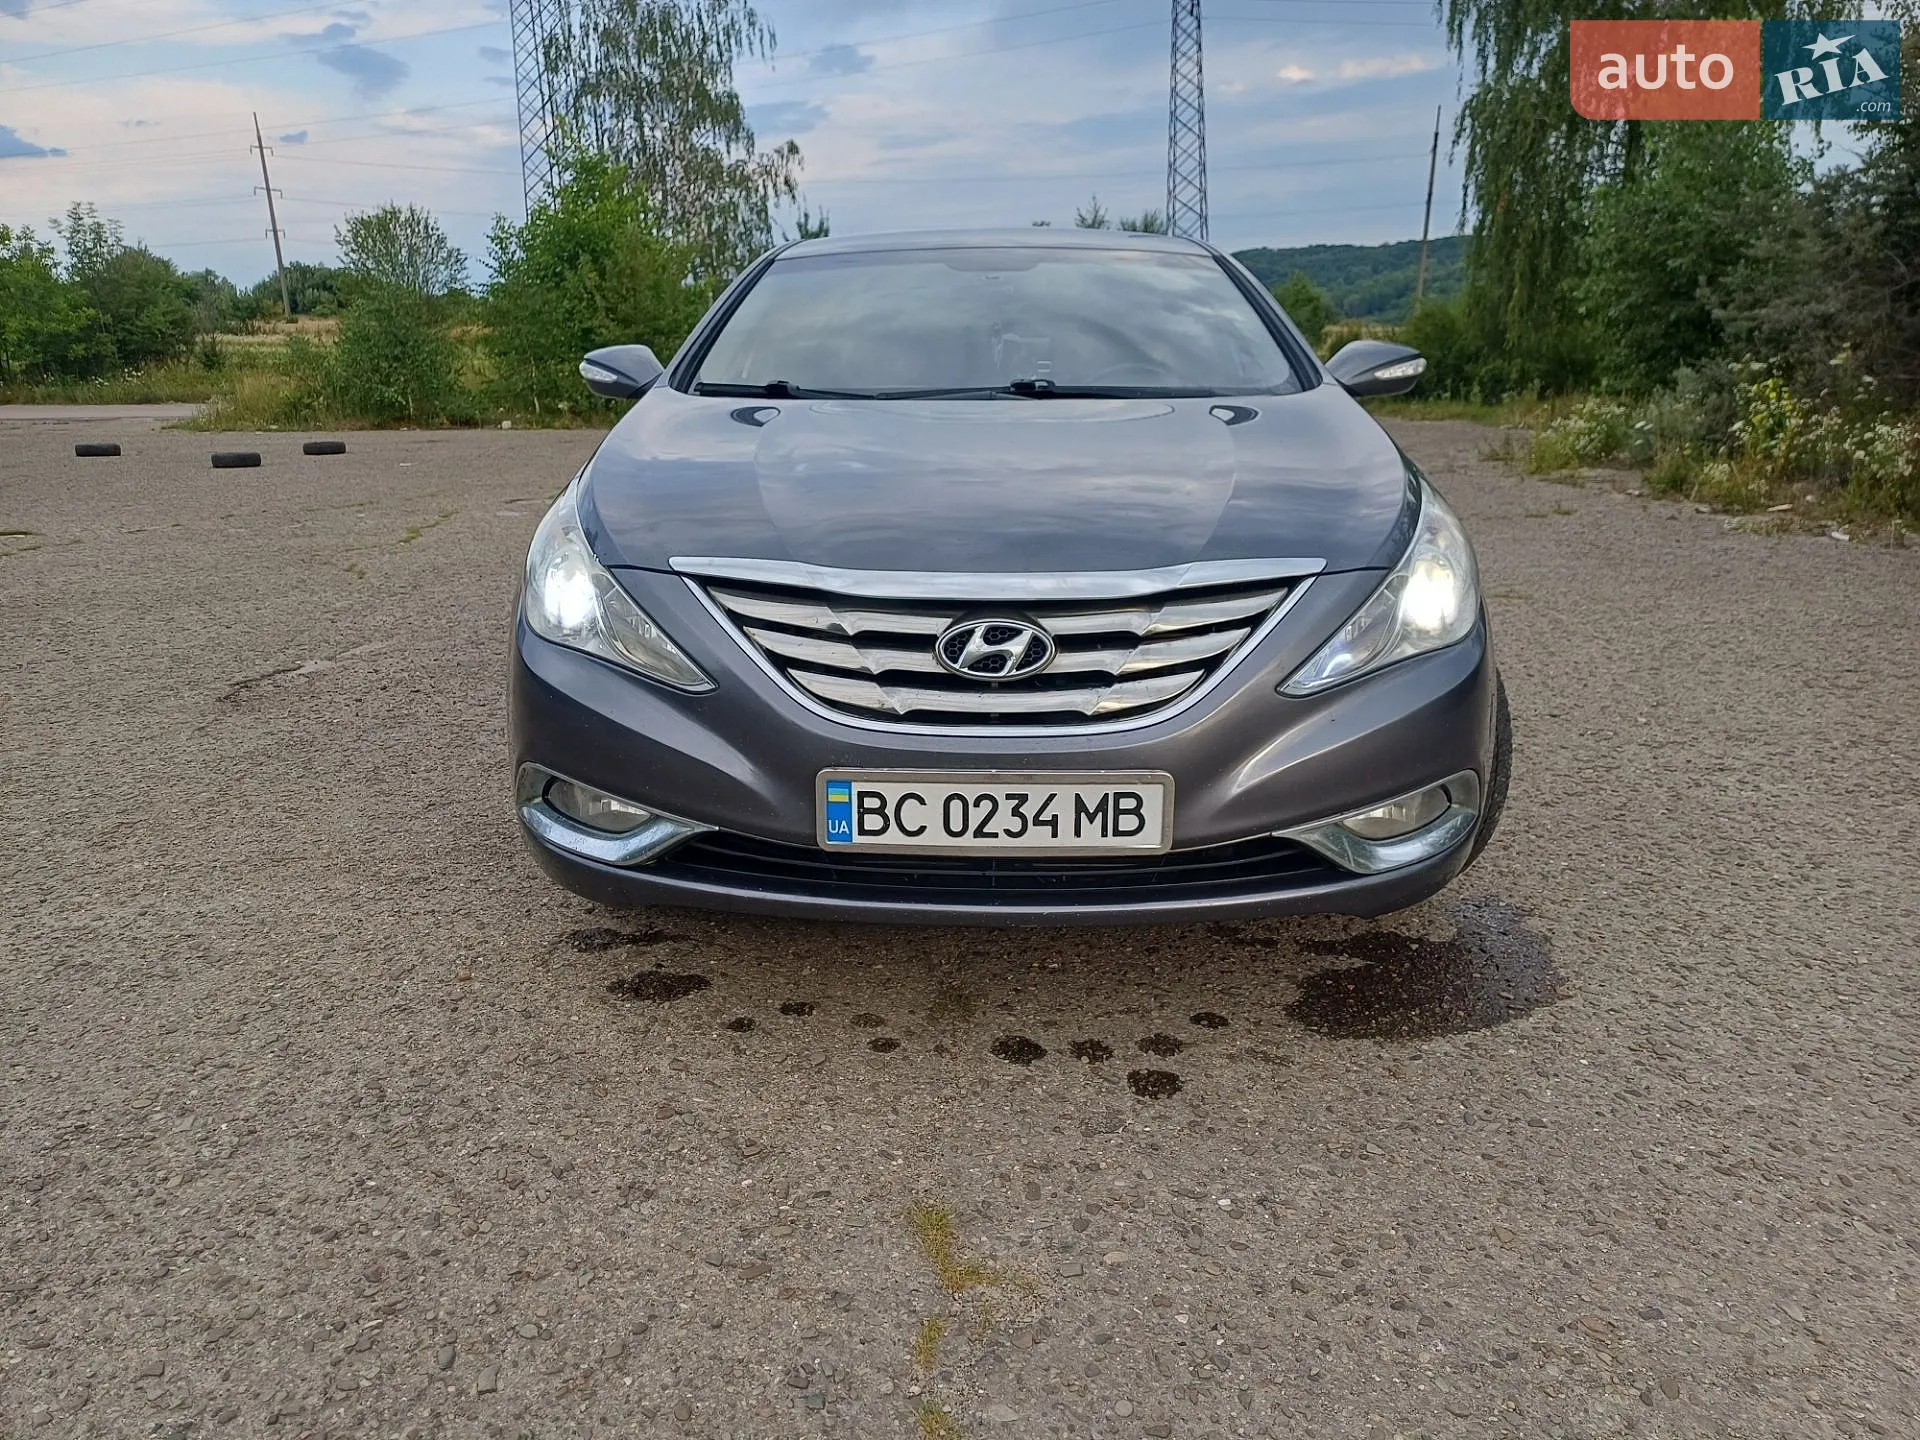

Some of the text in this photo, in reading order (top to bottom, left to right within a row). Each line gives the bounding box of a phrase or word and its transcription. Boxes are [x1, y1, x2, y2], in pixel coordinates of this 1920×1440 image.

[828, 820, 849, 834] UA
[856, 790, 1146, 838] BC 0234 MB
